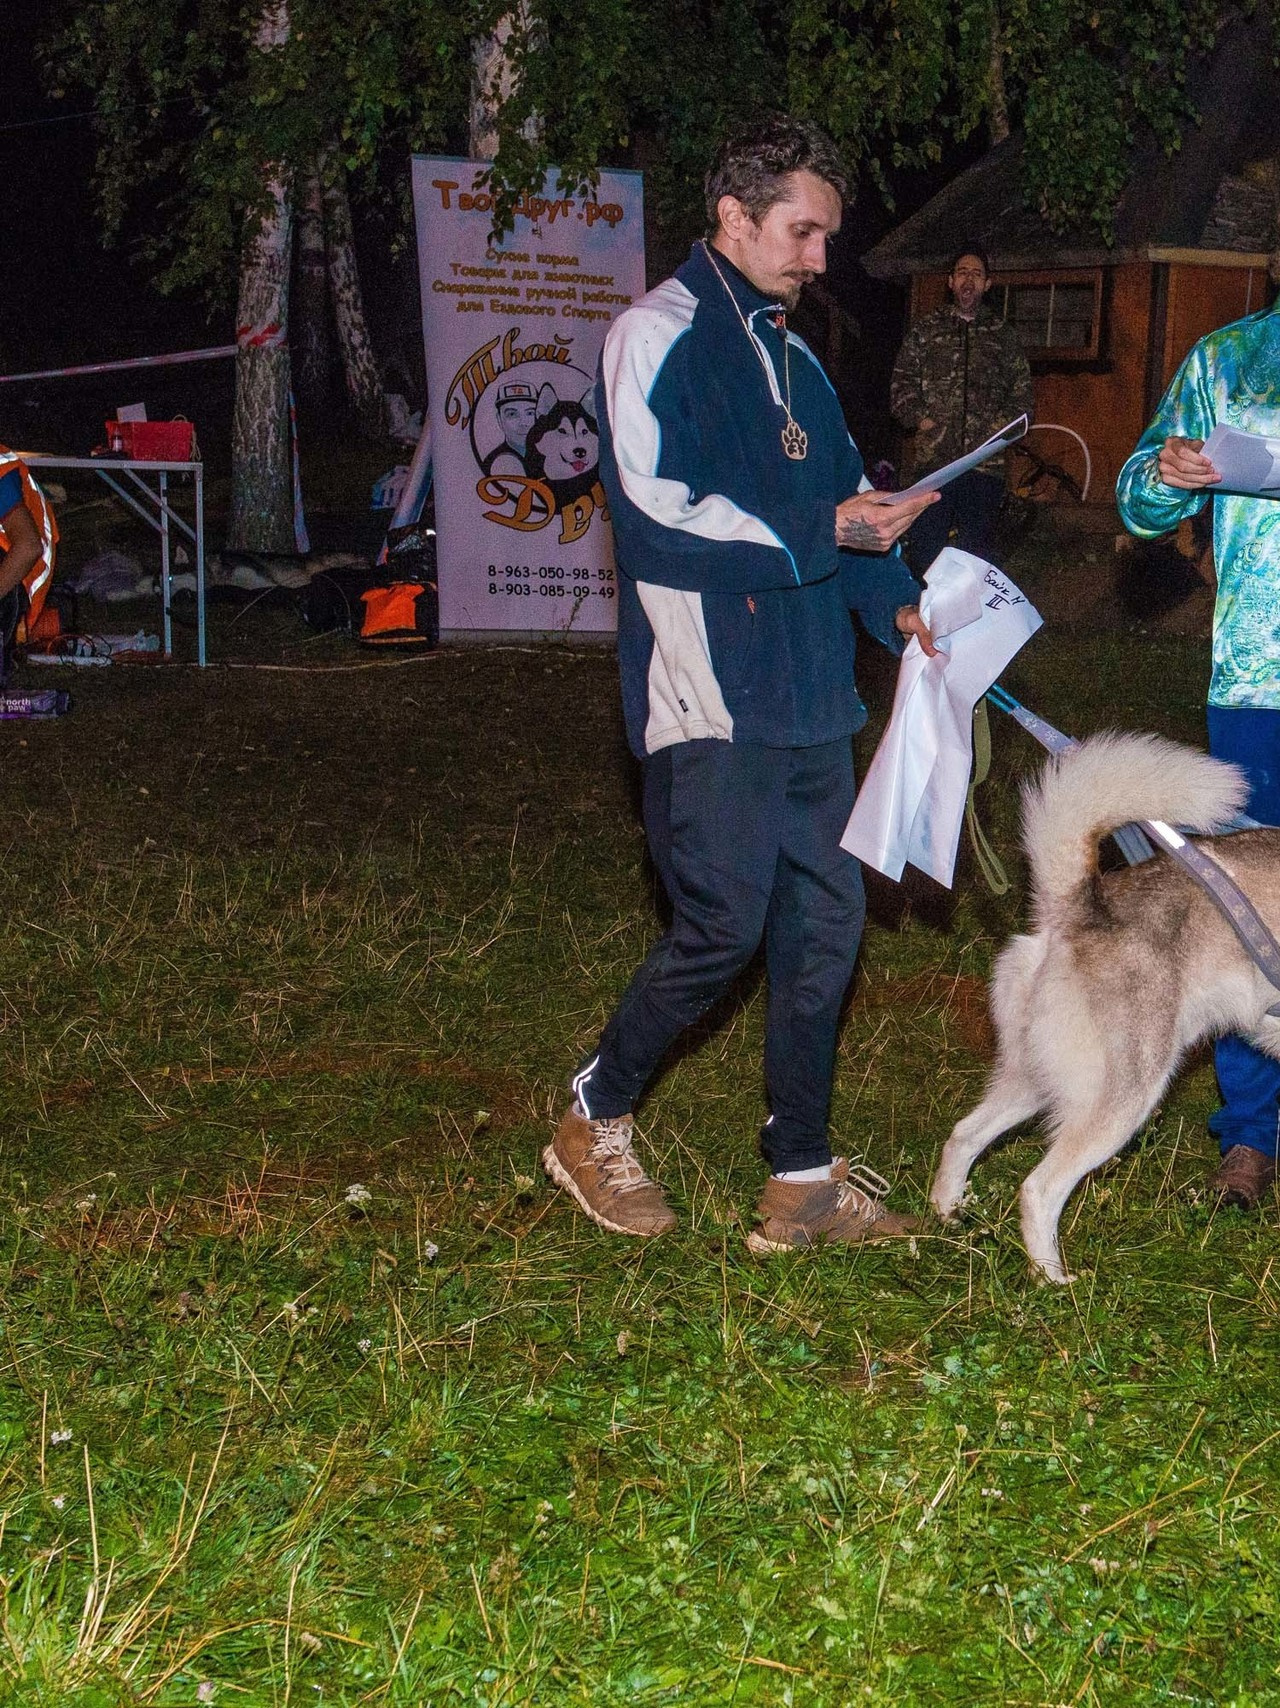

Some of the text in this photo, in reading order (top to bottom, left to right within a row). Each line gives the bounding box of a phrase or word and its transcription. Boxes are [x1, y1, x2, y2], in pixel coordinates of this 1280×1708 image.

[432, 180, 624, 228] ТвоДруг.рф
[526, 287, 577, 302] ручной
[444, 327, 575, 430] Твой
[487, 565, 615, 581] 8-963-050-98-52
[488, 583, 615, 599] 8-903-085-09-49
